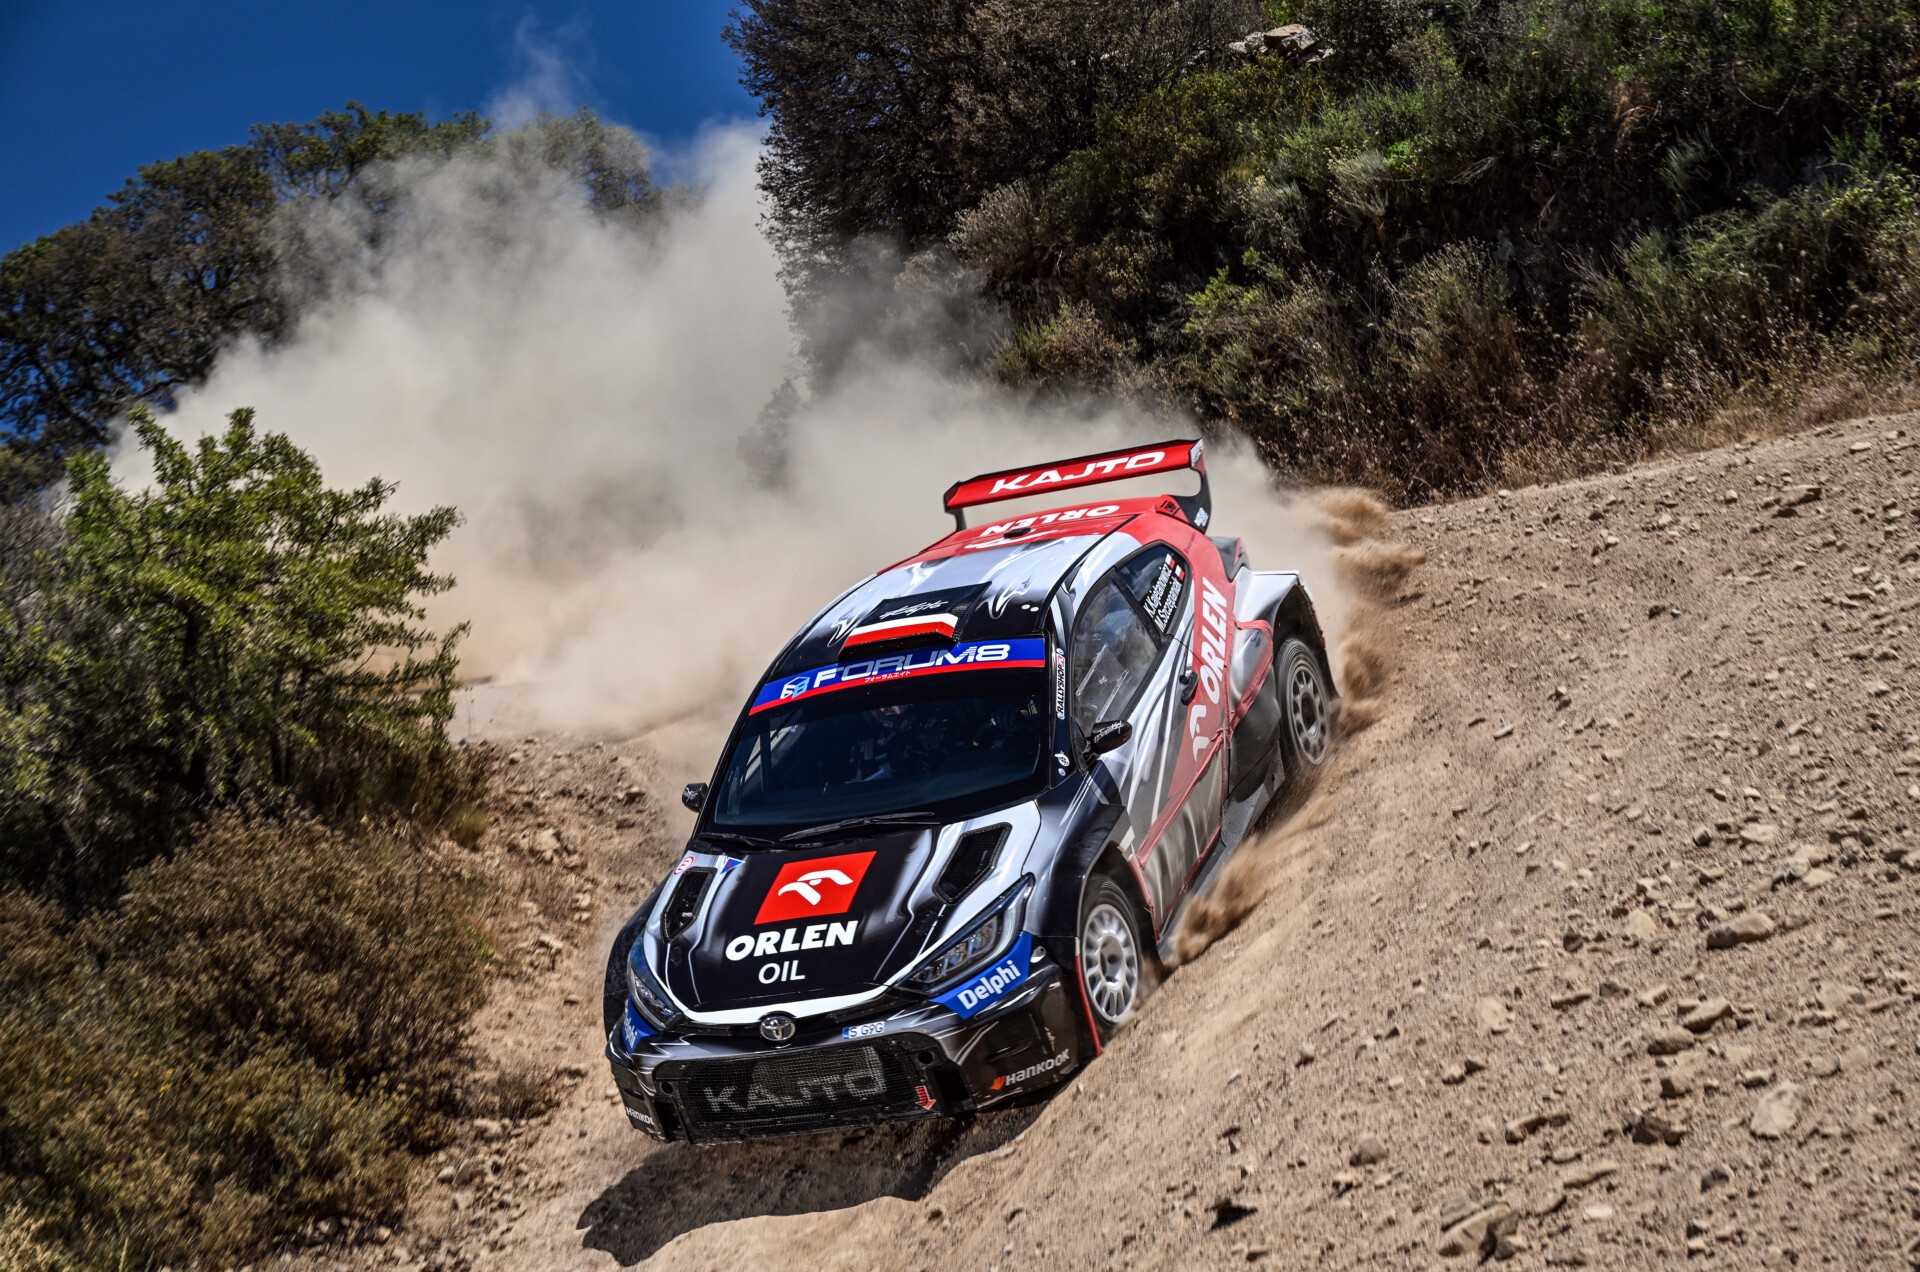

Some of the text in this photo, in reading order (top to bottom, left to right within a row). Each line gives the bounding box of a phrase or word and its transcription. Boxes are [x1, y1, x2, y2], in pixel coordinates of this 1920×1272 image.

[988, 451, 1166, 495] KAJTO
[979, 505, 1120, 538] ORLEN
[1200, 577, 1228, 704] ORLEN
[813, 644, 1011, 689] FORUM8
[864, 670, 911, 683] フォーラムエイト
[725, 920, 859, 961] ORLEN
[758, 960, 806, 984] OIL
[956, 960, 1021, 1010] Delphi
